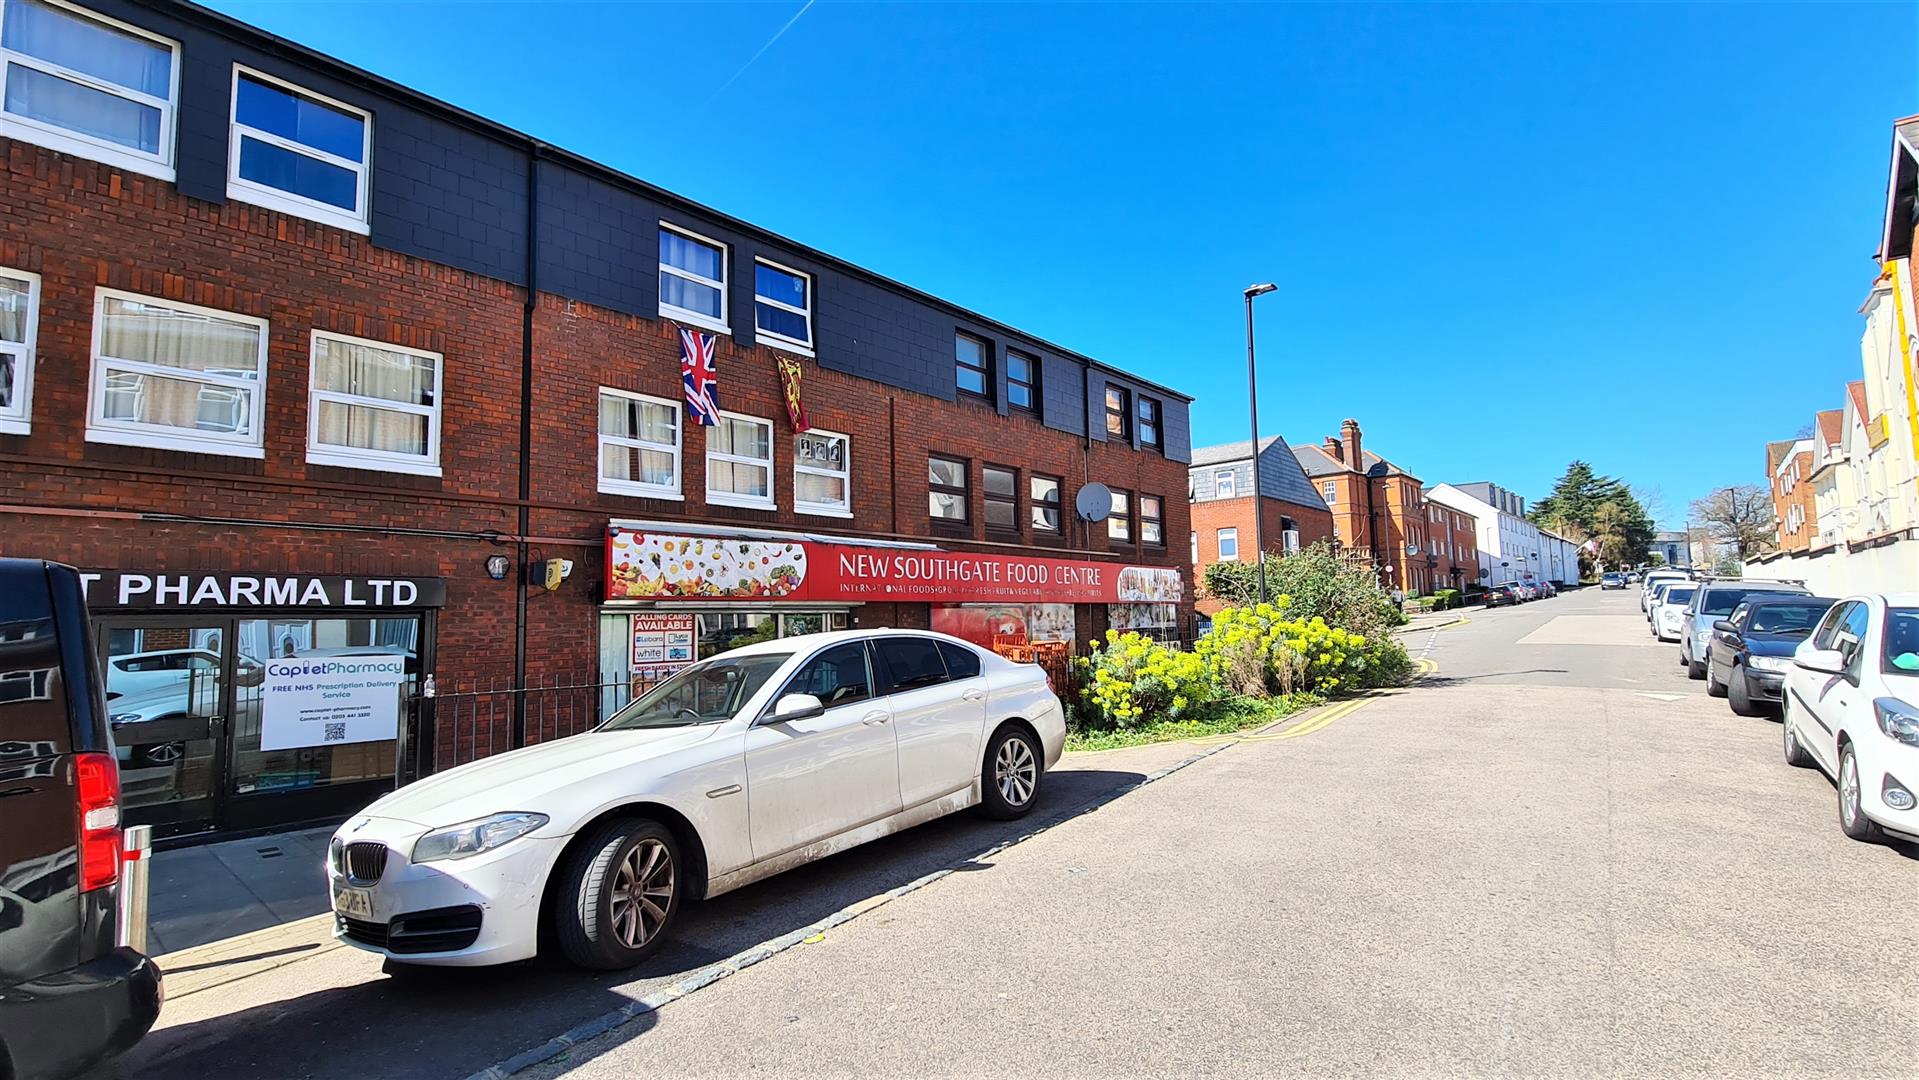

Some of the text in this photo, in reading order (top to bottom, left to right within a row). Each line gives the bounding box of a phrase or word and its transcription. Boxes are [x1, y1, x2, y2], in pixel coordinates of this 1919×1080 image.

[840, 553, 1101, 586] NEW SOUTHGATE FOOD CENTRE
[118, 574, 331, 606] PHARMA
[344, 579, 418, 606] LTD
[635, 621, 693, 630] AVAILABLE
[636, 649, 662, 658] white
[316, 682, 364, 690] Prescription
[322, 691, 351, 699] Service
